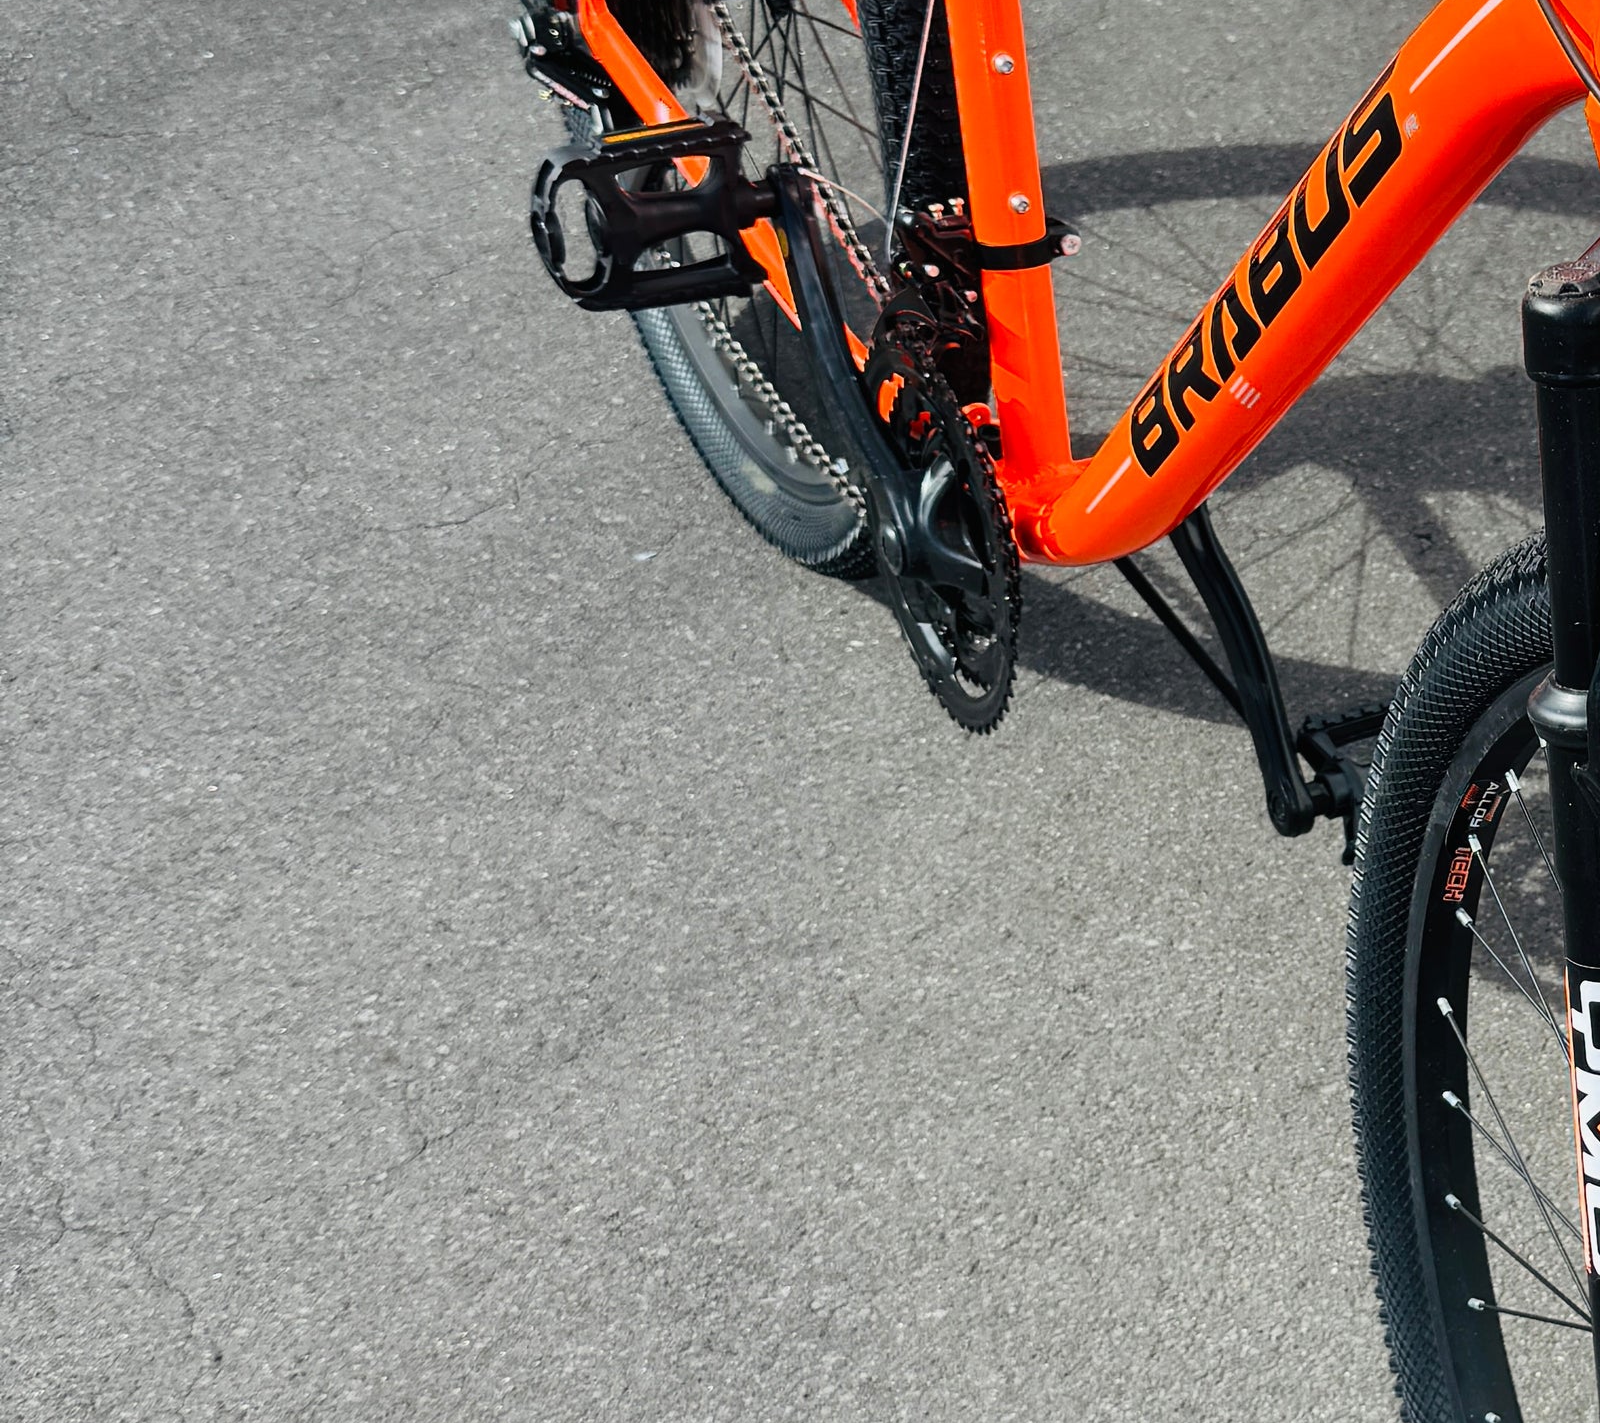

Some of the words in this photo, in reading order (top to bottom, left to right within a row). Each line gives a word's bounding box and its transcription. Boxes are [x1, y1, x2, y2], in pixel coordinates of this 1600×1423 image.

[1131, 54, 1402, 478] BRABUS
[1467, 780, 1500, 828] ALLOY
[1441, 846, 1474, 903] TECH
